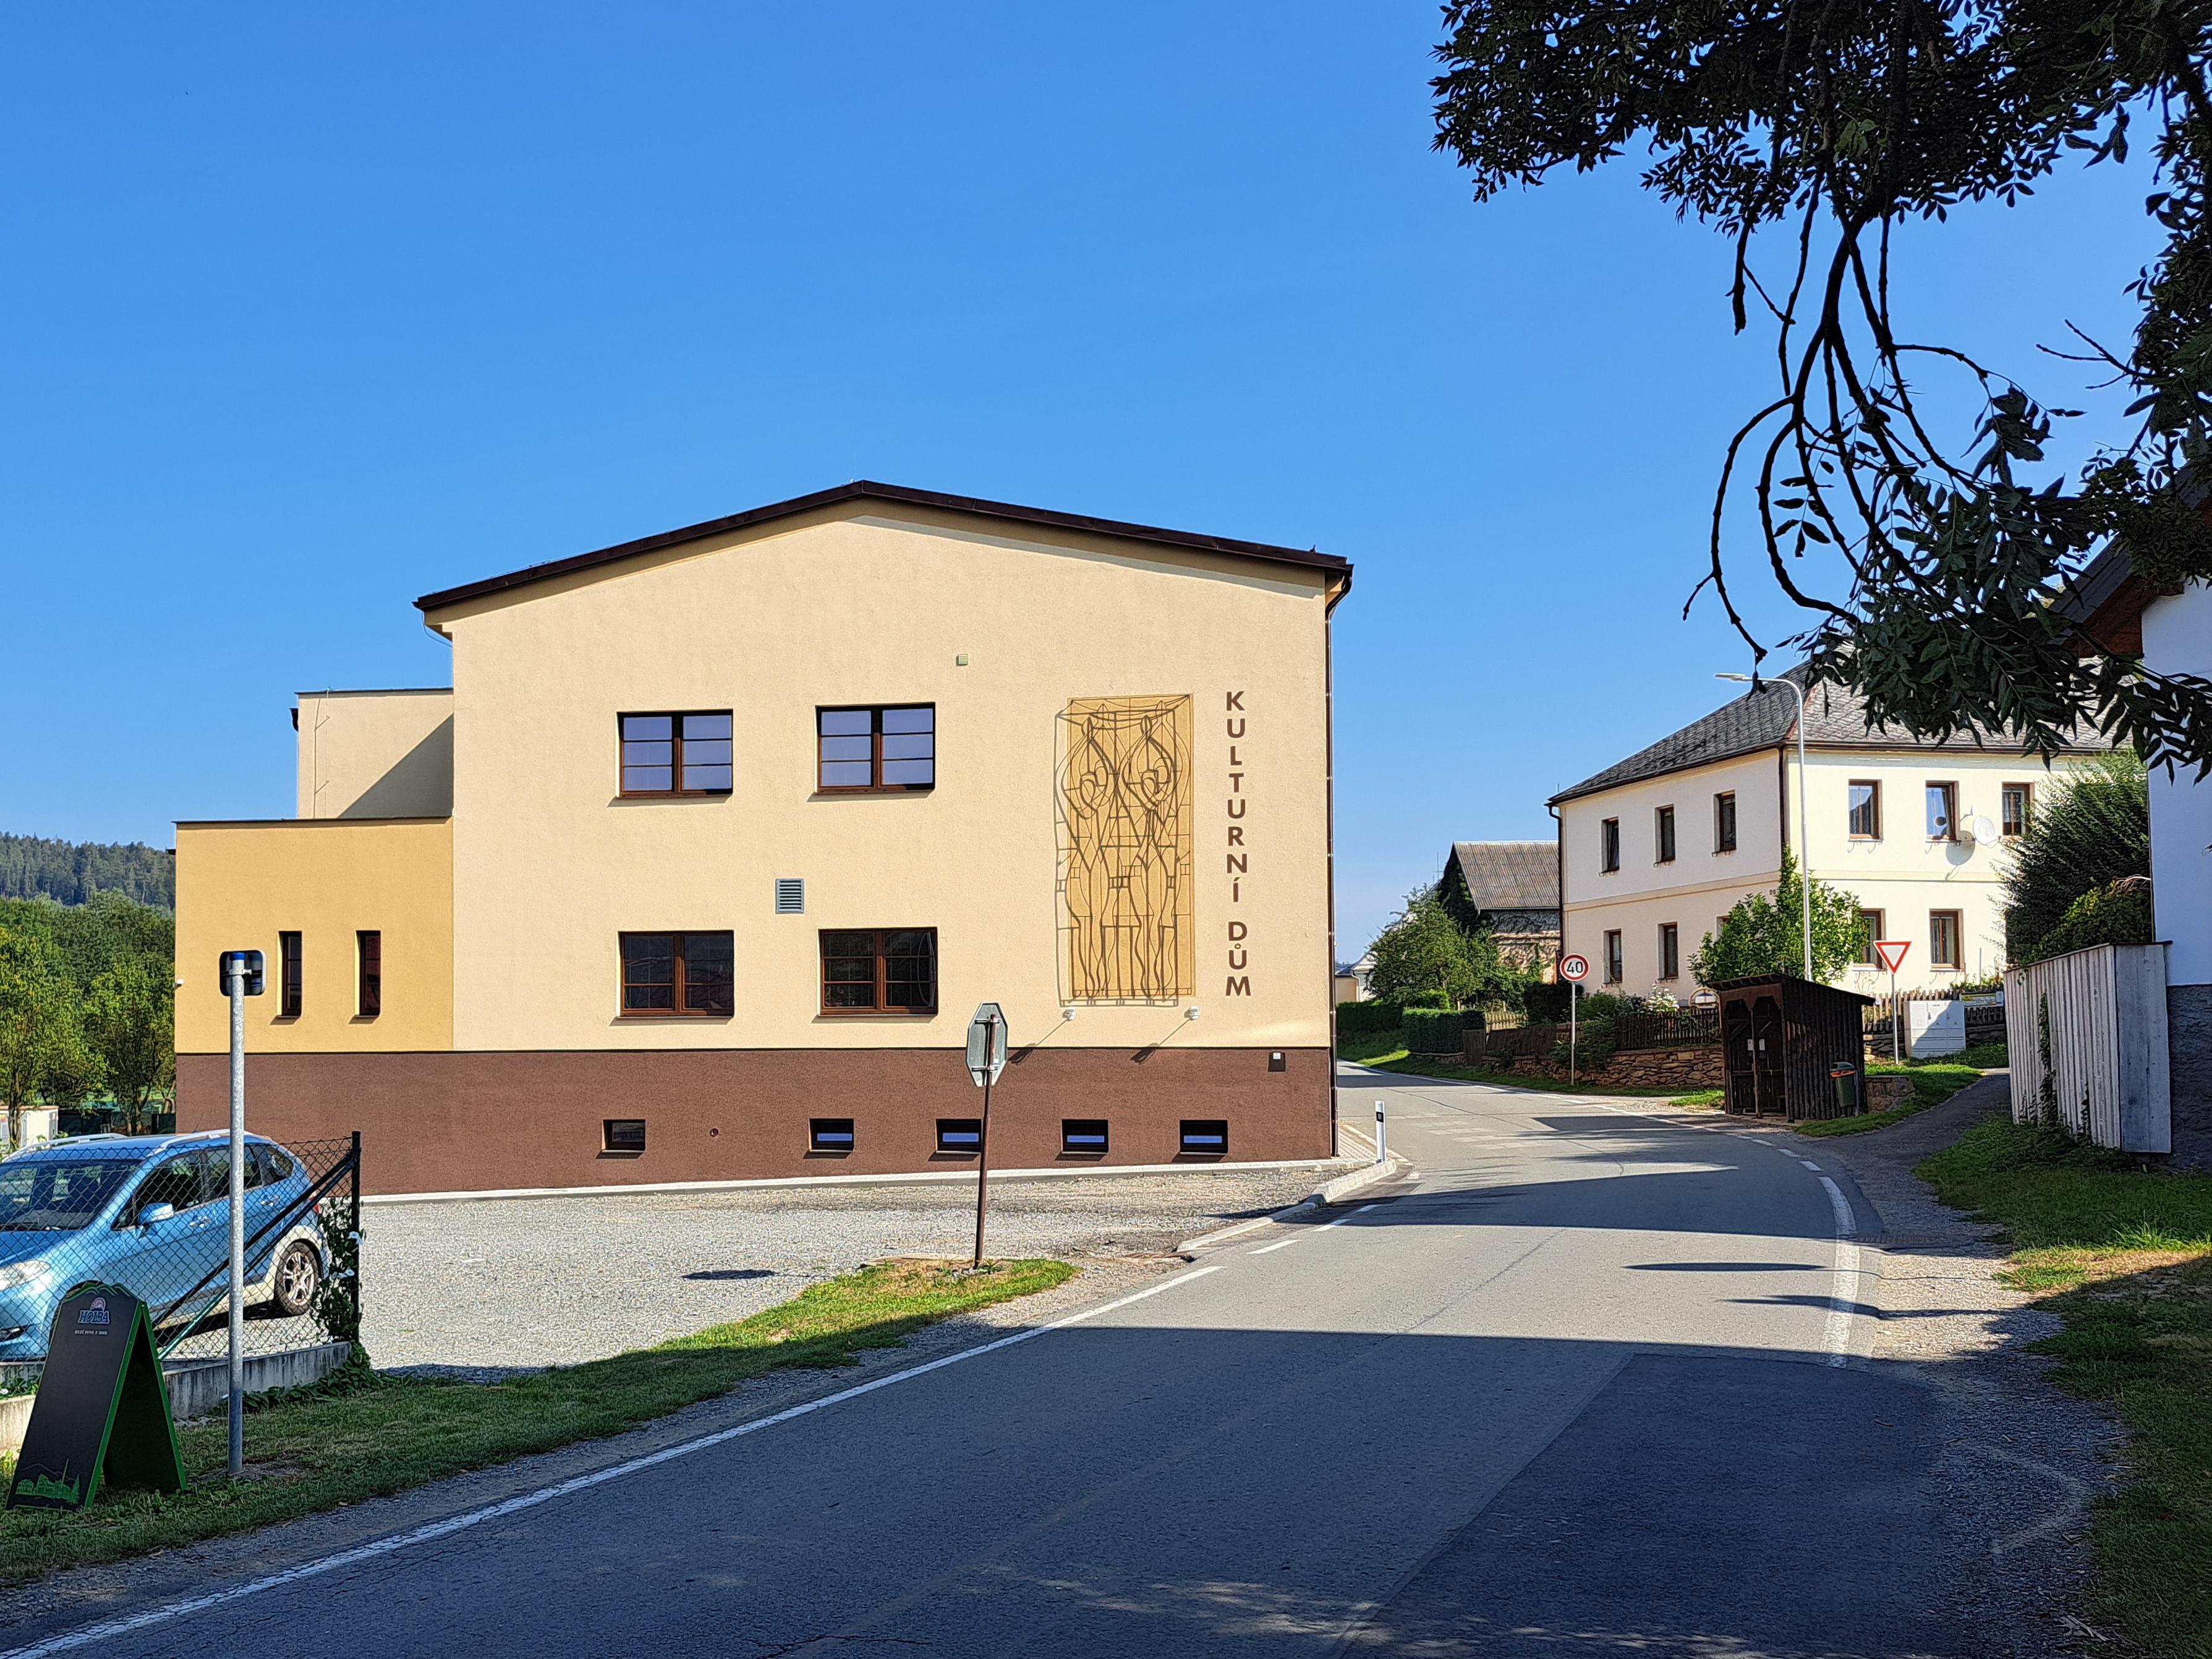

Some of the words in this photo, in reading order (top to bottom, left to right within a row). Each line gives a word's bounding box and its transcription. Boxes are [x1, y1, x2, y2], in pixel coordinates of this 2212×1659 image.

[1225, 690, 1248, 902] KULTURNÍ
[1225, 921, 1251, 996] DŮM
[1567, 961, 1583, 974] 40
[79, 1310, 109, 1323] HOLBA
